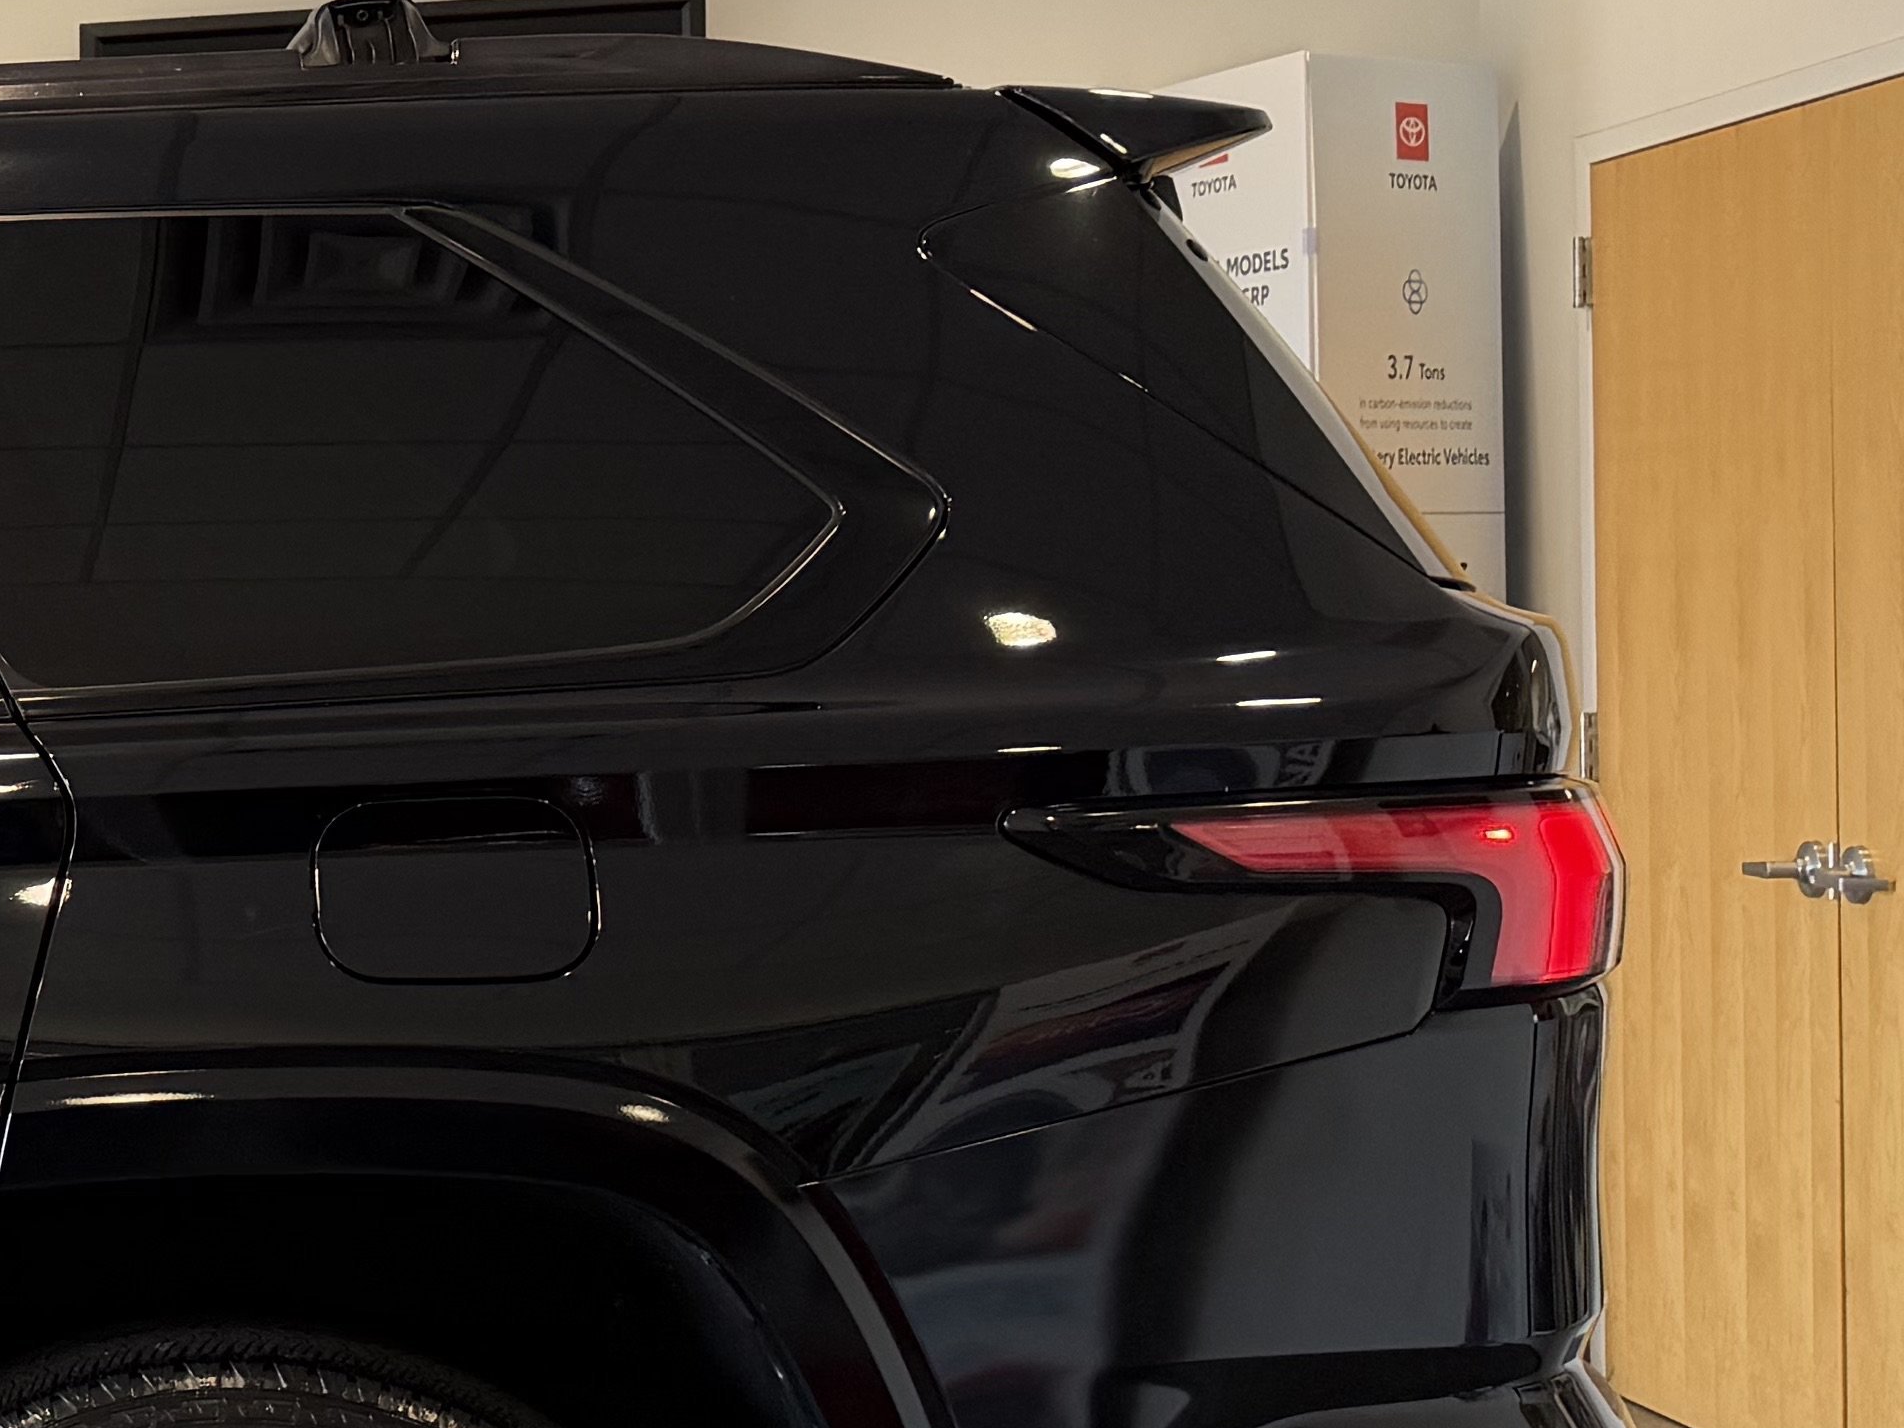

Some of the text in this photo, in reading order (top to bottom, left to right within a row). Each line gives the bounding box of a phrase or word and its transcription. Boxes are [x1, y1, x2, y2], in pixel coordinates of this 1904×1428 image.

[1192, 175, 1237, 198] TOYOTA
[1389, 172, 1438, 191] TOYOTA
[1226, 248, 1289, 277] MODELS
[1388, 355, 1445, 380] 3.7 Tons
[1398, 448, 1442, 465] Electric
[1444, 447, 1490, 465] Vehicles
